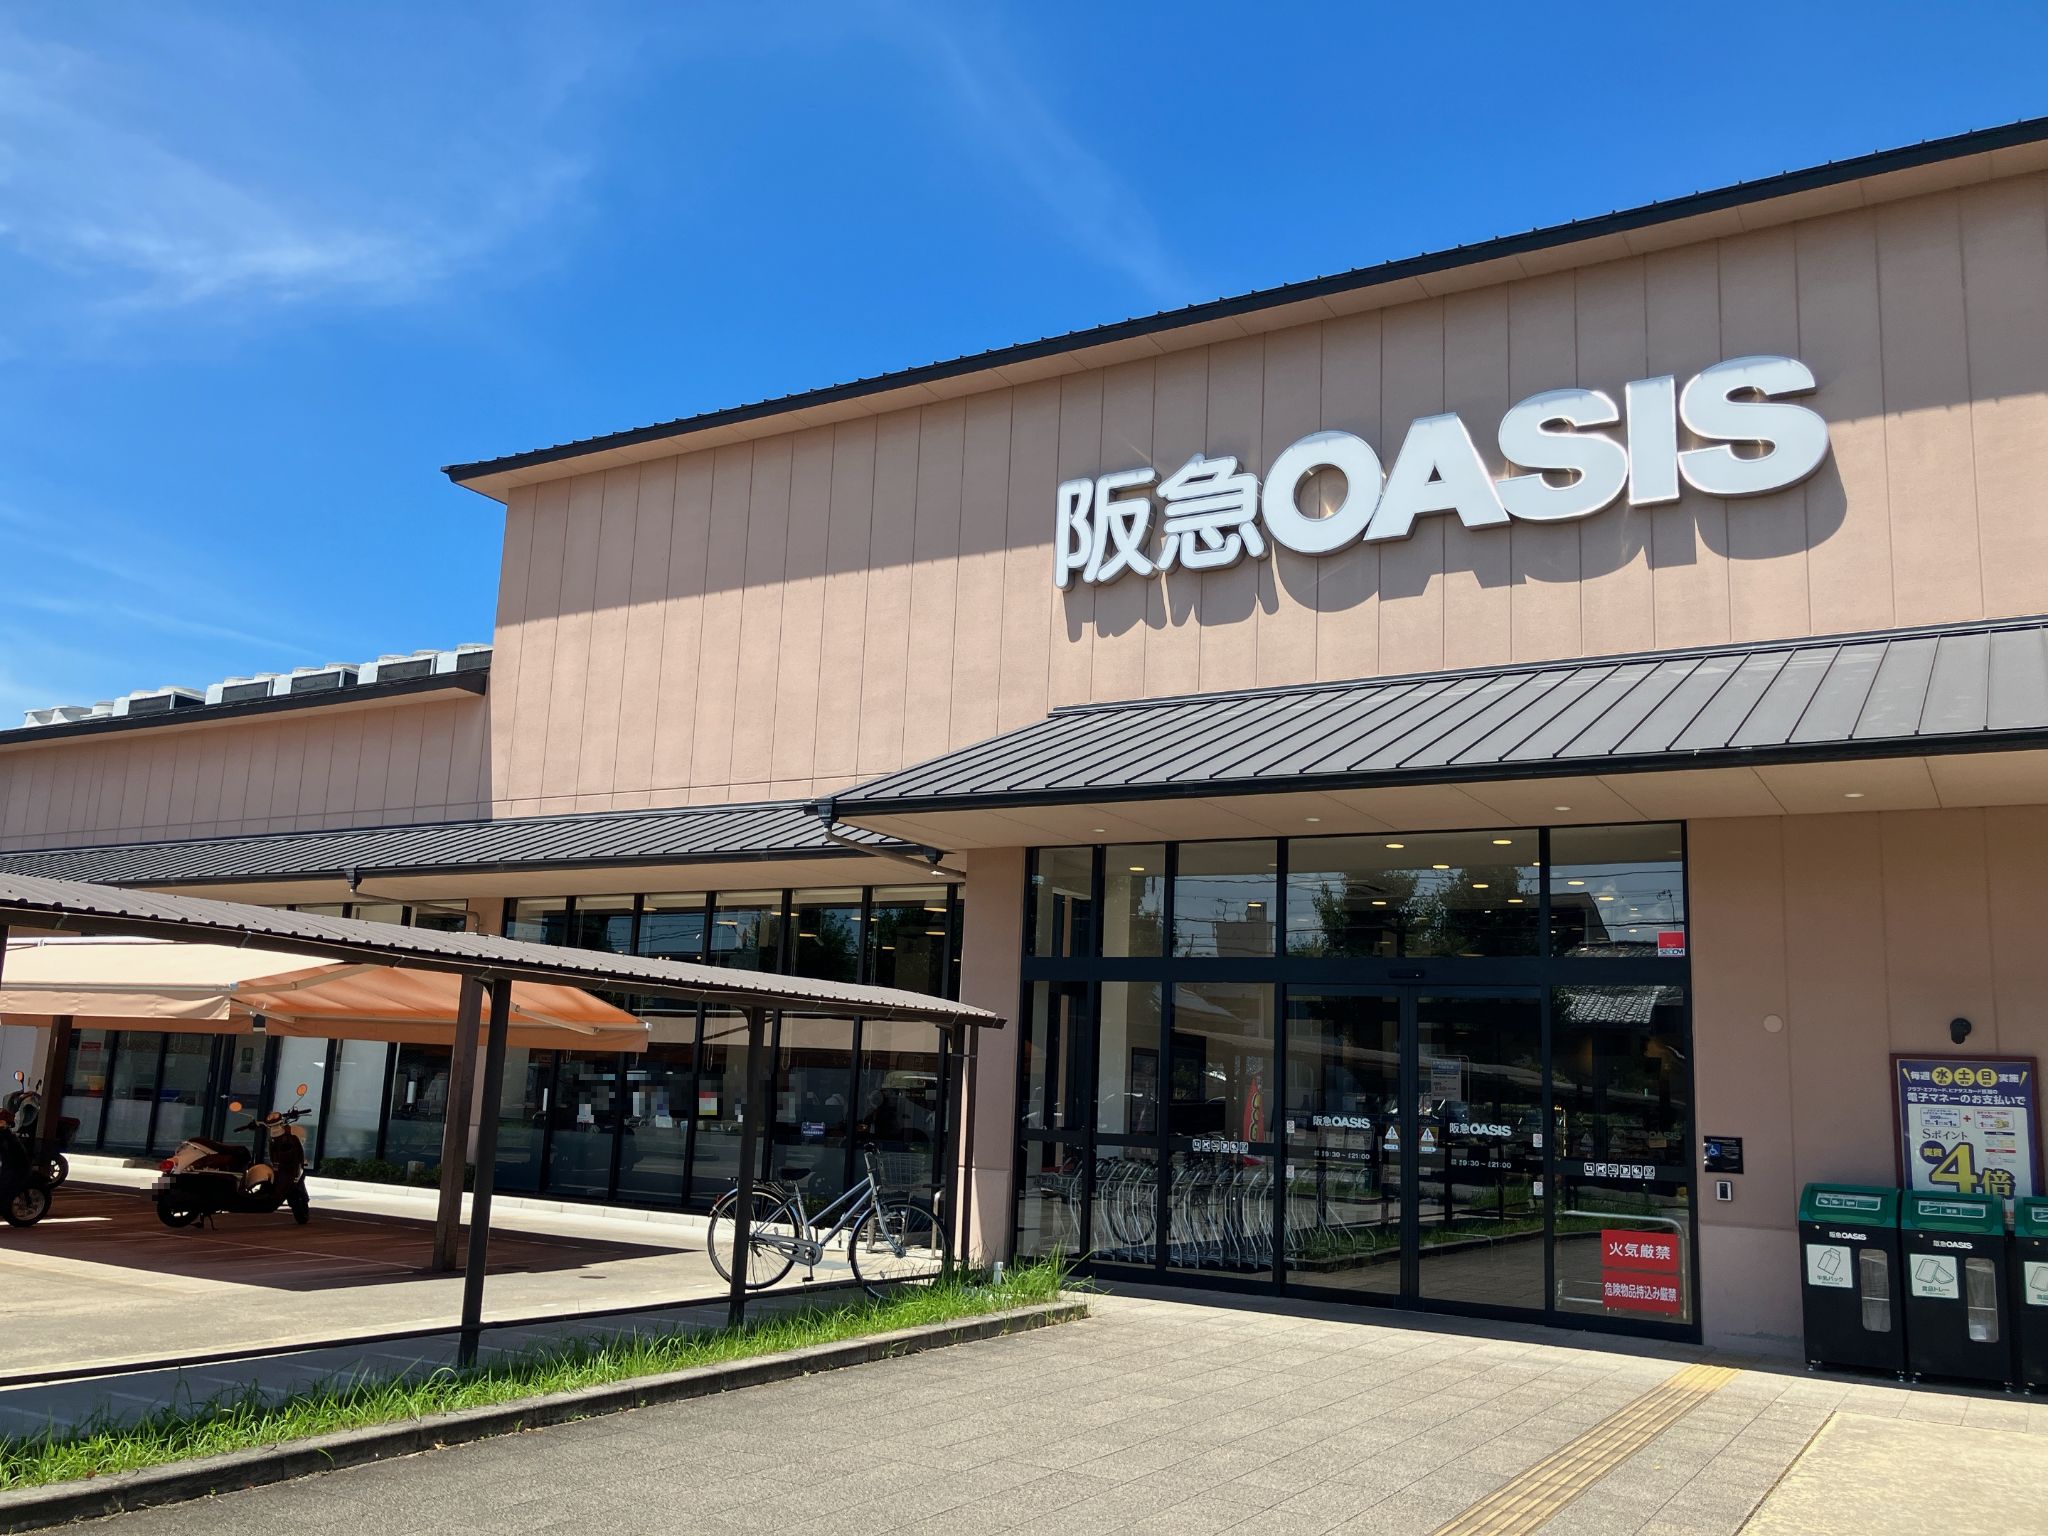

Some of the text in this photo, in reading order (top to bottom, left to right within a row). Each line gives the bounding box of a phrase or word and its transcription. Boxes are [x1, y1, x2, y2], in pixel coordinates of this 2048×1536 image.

[1055, 355, 1828, 591] 阪急OASIS
[1936, 1069, 1949, 1080] 水
[1958, 1070, 1971, 1080] 土
[1981, 1070, 1992, 1081] 日
[1907, 1092, 2026, 1106] 電子マネーのお支払いで
[1313, 1115, 1371, 1129] 阪急OASIS
[1449, 1122, 1512, 1137] 阪急OASIS
[1922, 1128, 1968, 1140] Sポイント
[1609, 1241, 1671, 1260] 火気厳禁
[1604, 1281, 1677, 1302] 危険物品持込み厳禁
